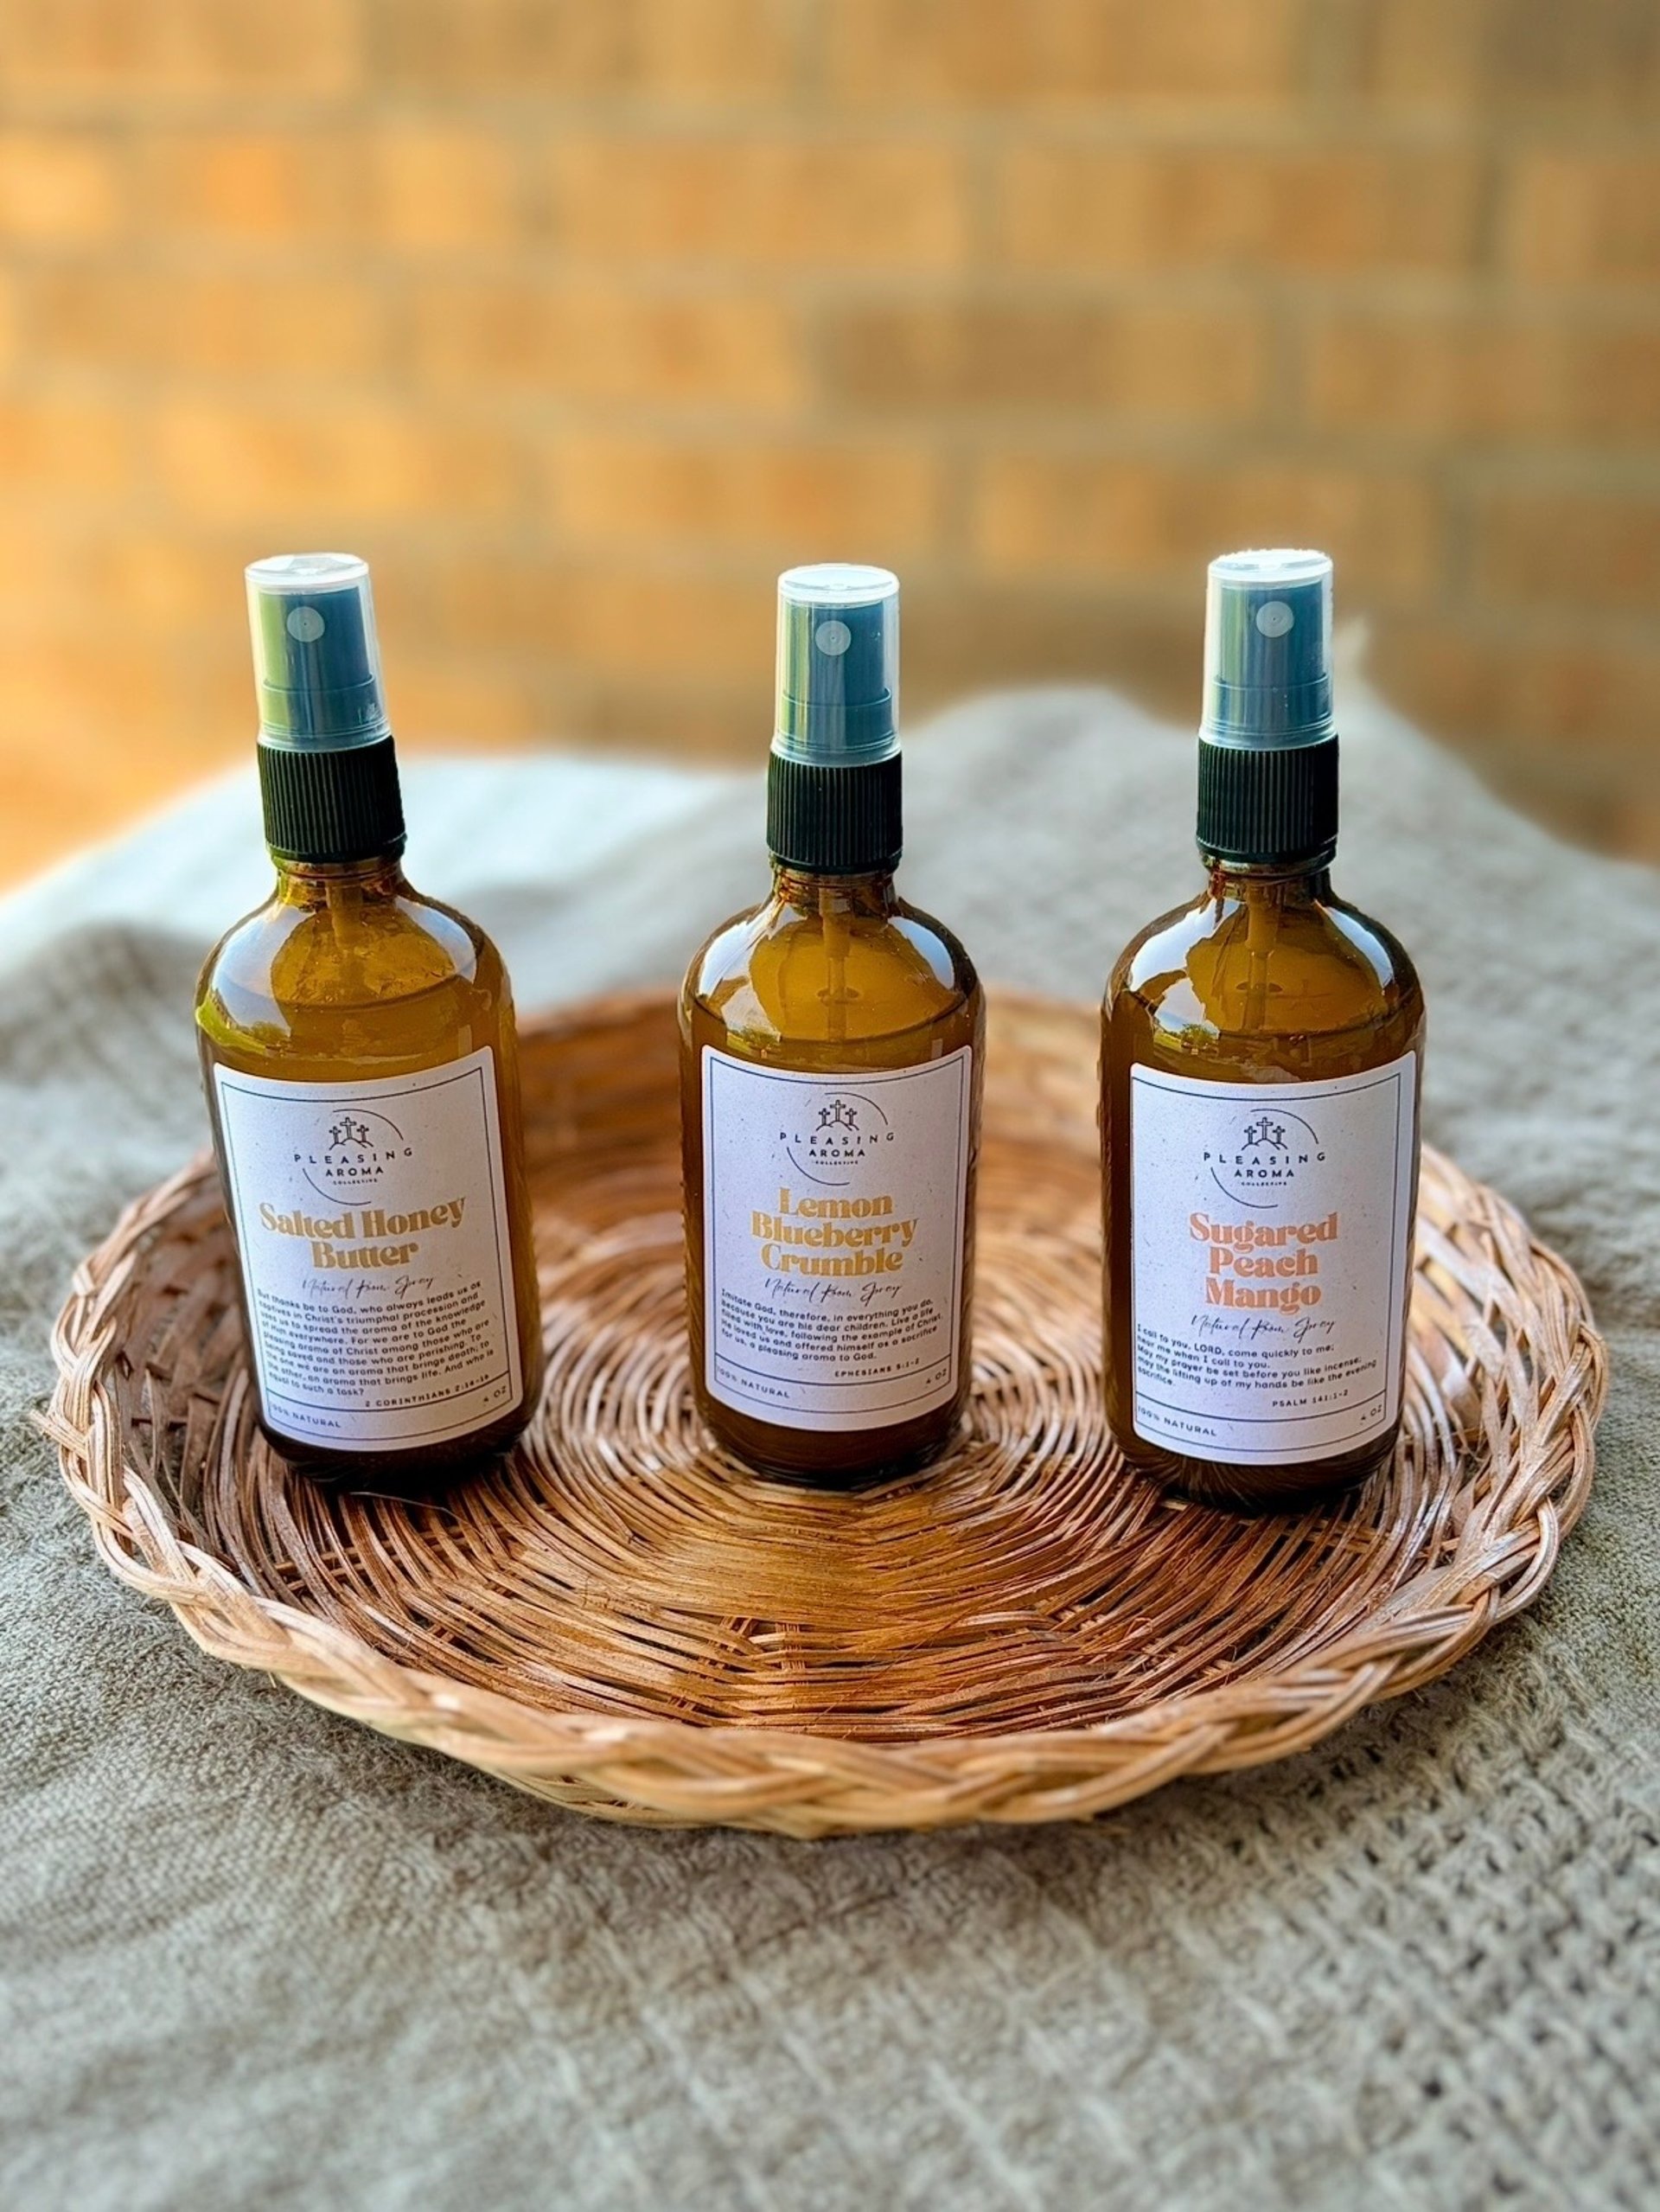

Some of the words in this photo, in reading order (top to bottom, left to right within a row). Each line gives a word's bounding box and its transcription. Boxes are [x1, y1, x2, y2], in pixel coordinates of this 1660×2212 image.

[780, 1132, 894, 1145] PLEASING
[294, 1148, 412, 1164] PLEASING
[1204, 1152, 1325, 1165] PLEASING
[326, 1167, 384, 1176] AROMA
[1235, 1169, 1294, 1178] AROMA
[779, 1187, 893, 1218] Lemon
[259, 1201, 354, 1239] Salted
[362, 1197, 466, 1238] Honey
[751, 1211, 919, 1248] Blueberry
[1189, 1211, 1338, 1253] Sugared
[312, 1241, 419, 1269] Butter
[761, 1243, 903, 1276] Crumble
[1209, 1247, 1318, 1278] Peach
[332, 1306, 357, 1314] God,
[386, 1300, 424, 1312] always
[427, 1291, 454, 1304] leads
[722, 1288, 751, 1307] Imitate
[755, 1302, 776, 1315] God,
[779, 1309, 830, 1321] therefore,
[846, 1308, 899, 1321] everything
[902, 1303, 918, 1314] you
[1205, 1276, 1322, 1314] Mango
[347, 1314, 399, 1325] triumphal
[403, 1301, 459, 1321] procession
[461, 1292, 478, 1304] and
[758, 1314, 775, 1325] you
[778, 1320, 795, 1328] are
[798, 1321, 813, 1331] his
[844, 1321, 888, 1332] children.
[891, 1316, 910, 1326] Live
[920, 1307, 933, 1318] life
[303, 1324, 338, 1334] spread
[362, 1326, 397, 1334] aroma
[416, 1319, 432, 1327] the
[347, 1346, 378, 1355] Christ
[381, 1343, 418, 1354] among
[422, 1335, 450, 1347] those
[453, 1327, 473, 1339] who
[476, 1320, 489, 1331] are
[427, 1325, 448, 1335] God
[451, 1319, 466, 1329] the
[744, 1320, 763, 1331] with
[765, 1325, 788, 1338] love,
[791, 1330, 838, 1343] following
[861, 1328, 902, 1338] example
[905, 1322, 915, 1333] of
[722, 1327, 732, 1338] for
[758, 1344, 799, 1360] pleasing
[802, 1353, 836, 1362] aroma
[852, 1352, 877, 1361] God.
[734, 1325, 757, 1339] loved
[773, 1339, 791, 1347] and
[795, 1342, 833, 1352] offered
[837, 1341, 875, 1352] himself
[901, 1326, 937, 1344] sacrifice
[1143, 1328, 1157, 1339] call
[1159, 1334, 1168, 1343] to
[1172, 1339, 1191, 1350] you,
[1194, 1343, 1225, 1356] LORD,
[1229, 1349, 1257, 1358] come
[1261, 1349, 1299, 1359] quickly
[1156, 1353, 1168, 1365] my
[1172, 1359, 1203, 1371] prayer
[1206, 1366, 1219, 1375] be
[1242, 1370, 1278, 1378] before
[1281, 1371, 1300, 1379] you
[1304, 1367, 1321, 1376] like
[1157, 1345, 1171, 1353] me
[1173, 1351, 1199, 1361] when
[1211, 1358, 1230, 1366] call
[385, 1374, 418, 1384] brings
[422, 1370, 442, 1379] life.
[834, 1365, 891, 1378] EPHESIANS
[935, 1369, 947, 1381] OZ
[1204, 1378, 1217, 1386] up
[1235, 1381, 1251, 1390] my
[1255, 1380, 1287, 1389] hands
[1292, 1379, 1304, 1388] be
[1307, 1377, 1325, 1385] like
[1328, 1372, 1343, 1381] the
[1345, 1359, 1376, 1377] evening
[376, 1389, 450, 1406] CORINTHIANS
[493, 1385, 507, 1398] OZ
[741, 1378, 789, 1398] NATURAL
[1272, 1398, 1307, 1407] PSALM
[1312, 1389, 1348, 1403] 141:1-2
[292, 1412, 341, 1428] NATURAL
[1370, 1404, 1382, 1416] OZ
[1164, 1417, 1216, 1436] NATURAL
